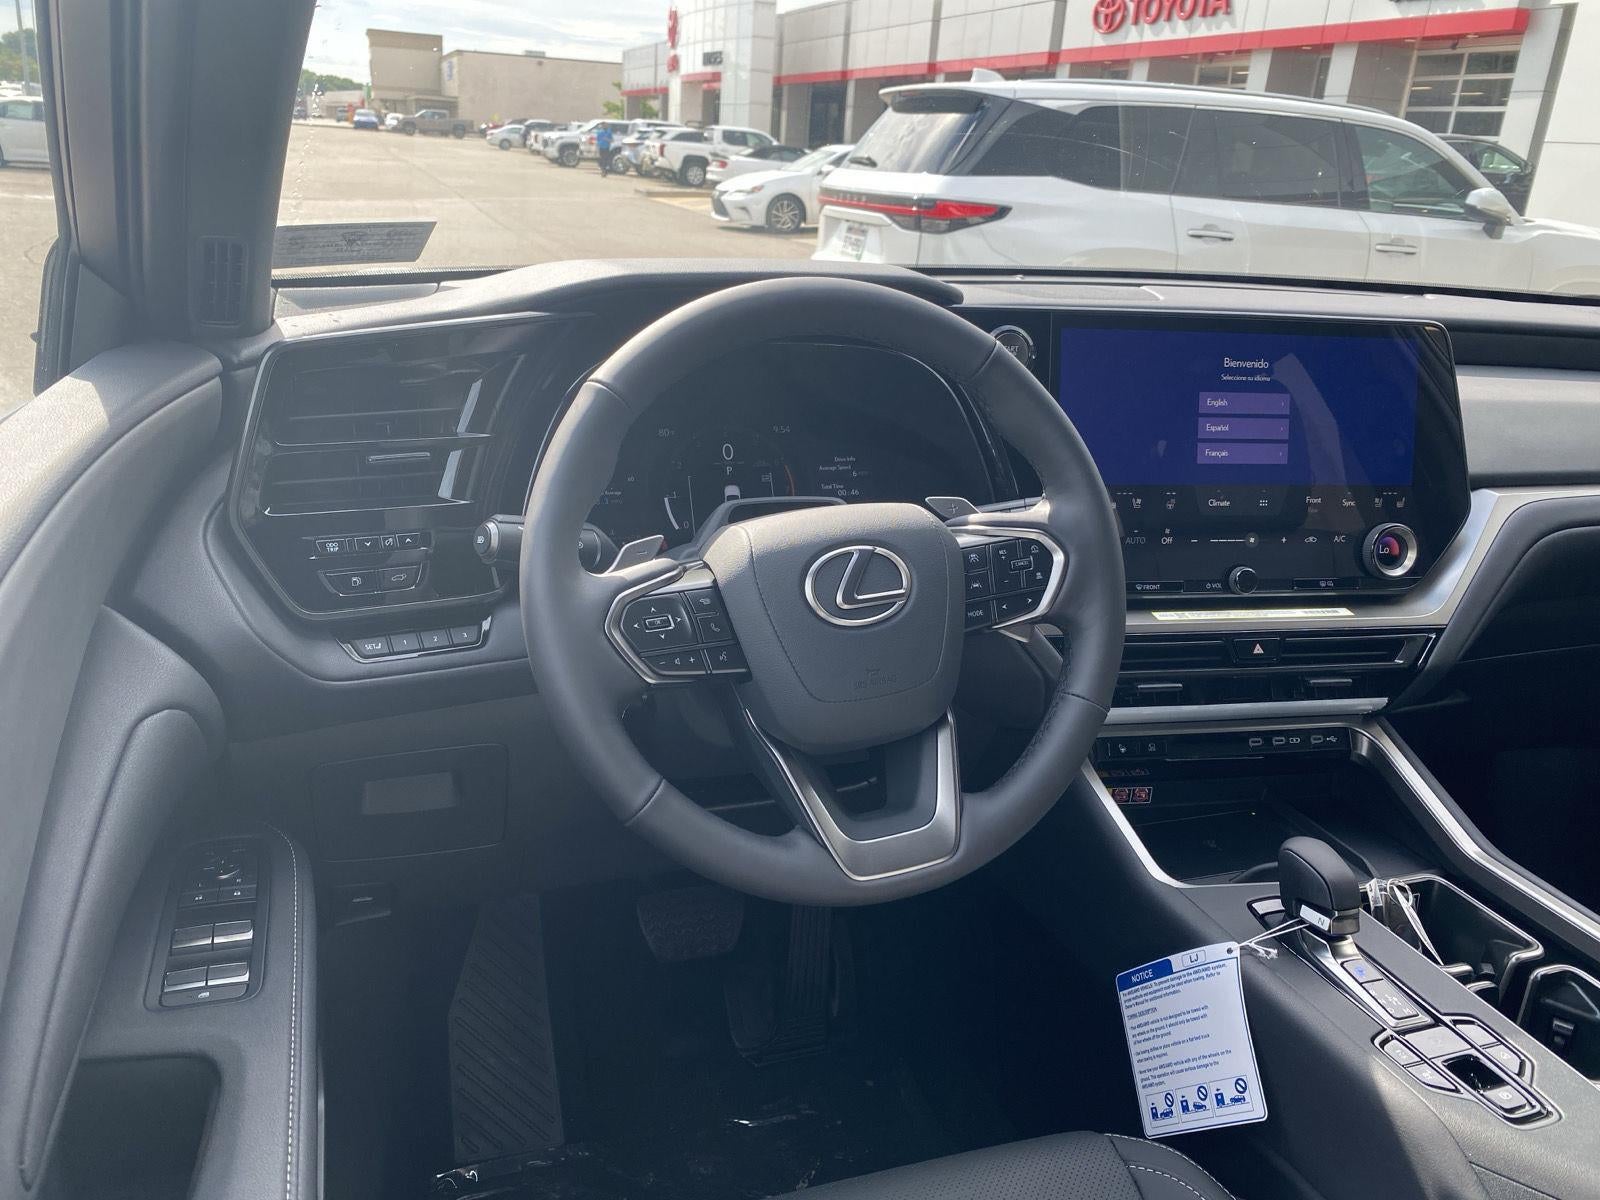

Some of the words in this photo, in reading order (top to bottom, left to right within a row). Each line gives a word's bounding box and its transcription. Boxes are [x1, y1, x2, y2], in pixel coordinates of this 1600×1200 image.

[1224, 357, 1269, 368] Bienvenido
[1207, 398, 1228, 407] English
[1206, 424, 1229, 432] Español
[722, 443, 734, 461] 0
[1205, 449, 1228, 458] Français
[726, 466, 733, 475] P
[1342, 499, 1356, 507] Sync
[1125, 537, 1146, 545] AUTO
[1161, 537, 1173, 545] Off
[1379, 544, 1389, 554] Lo
[1190, 954, 1199, 963] LJ
[1131, 969, 1154, 983] NOTICE
